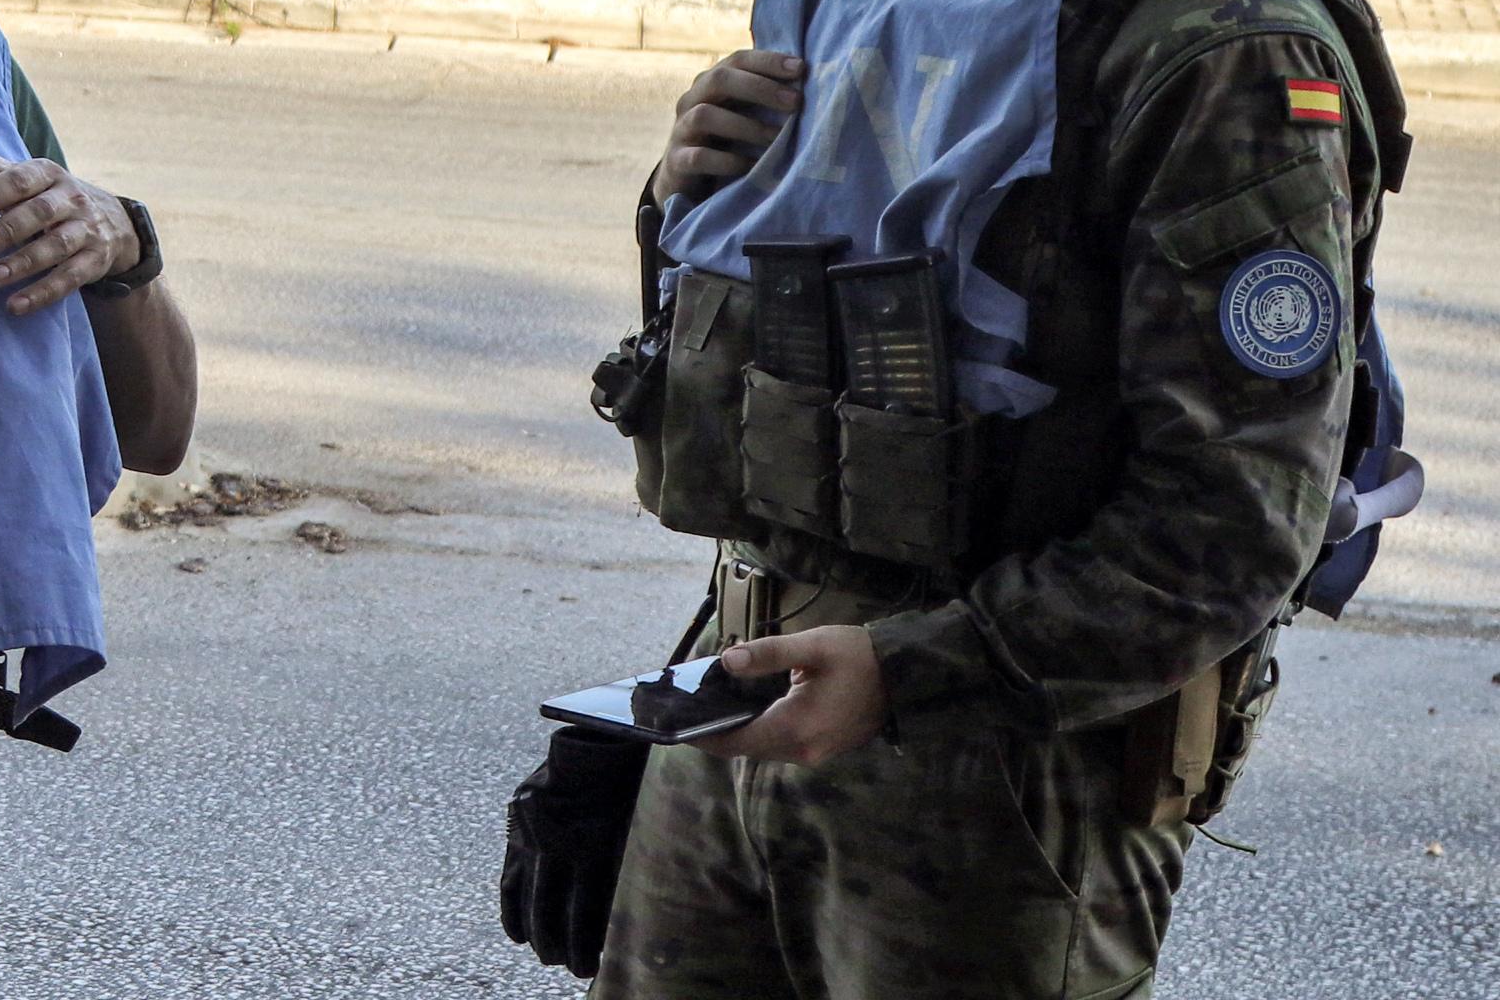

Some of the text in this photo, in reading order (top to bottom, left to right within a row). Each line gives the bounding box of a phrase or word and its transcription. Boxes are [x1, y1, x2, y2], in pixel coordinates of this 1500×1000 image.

[746, 47, 958, 194] N
[1233, 263, 1326, 314] UNITED NATIONS
[1240, 334, 1300, 366] NATIONS
